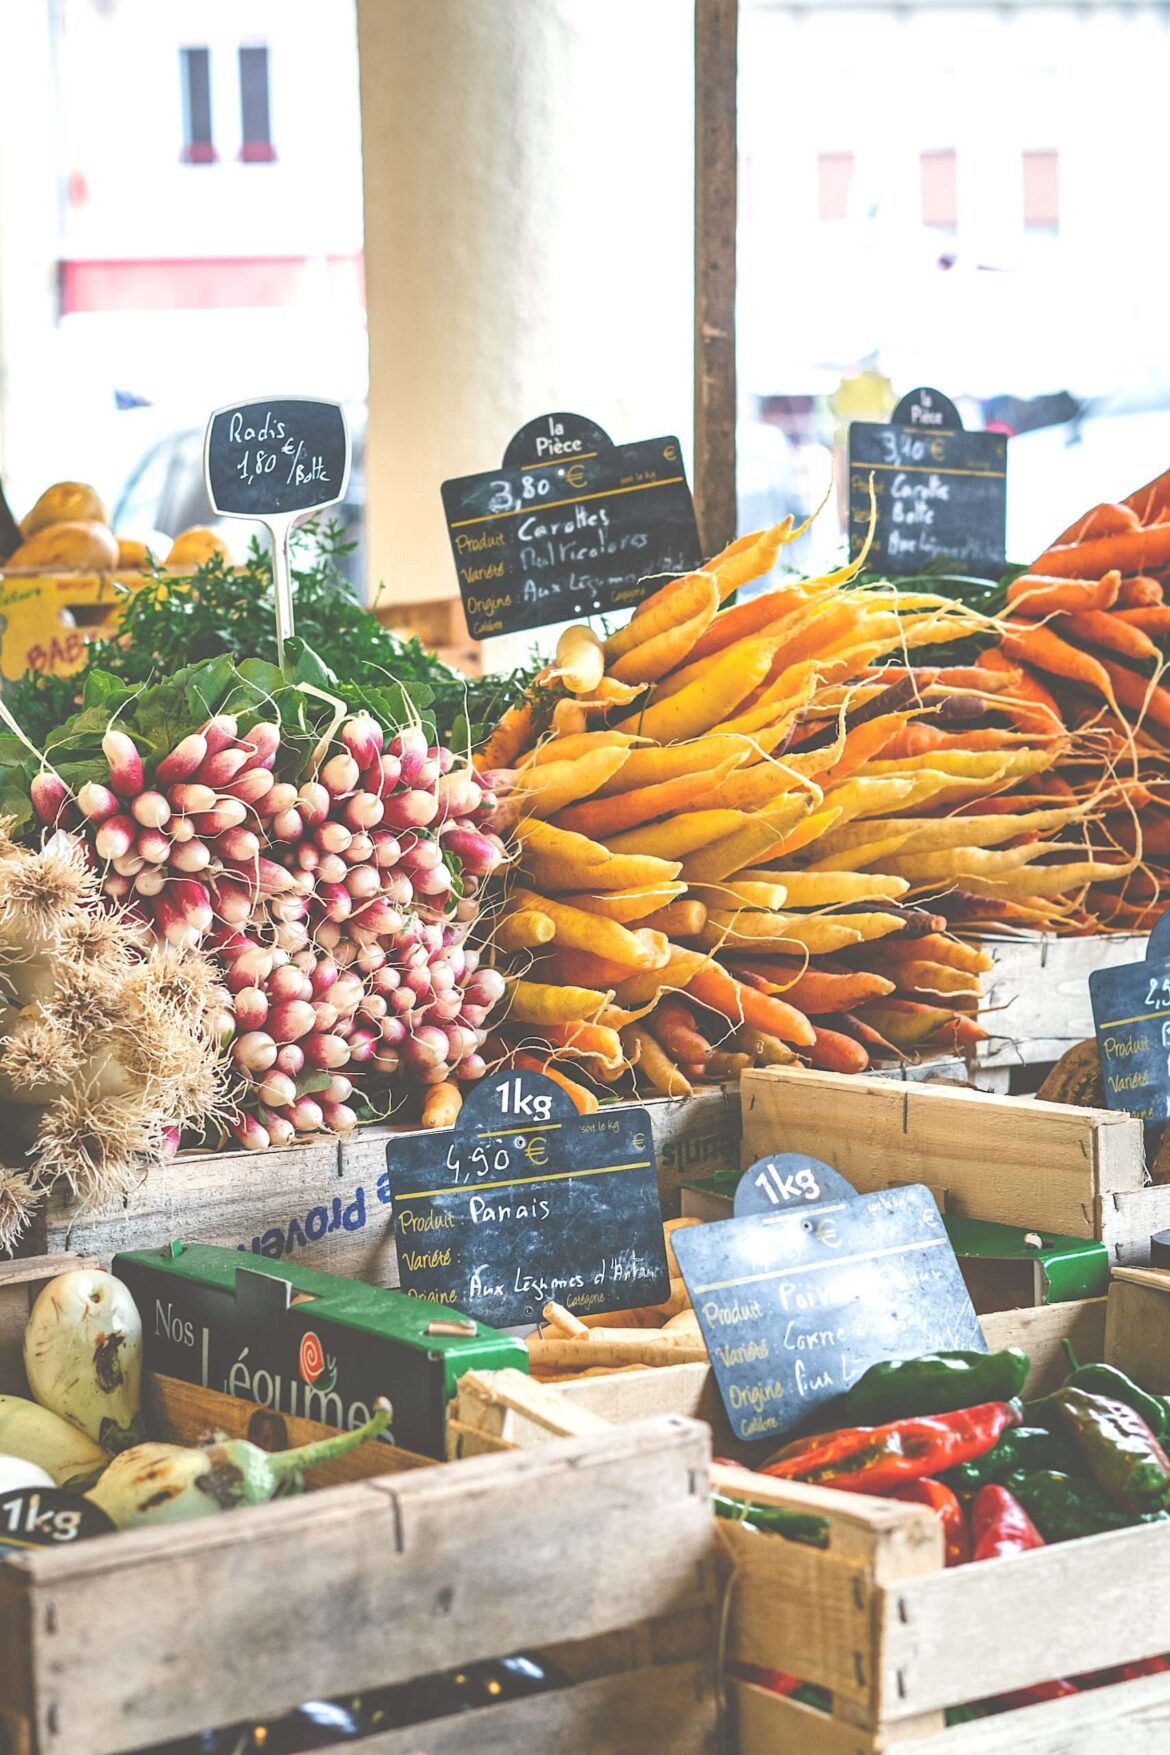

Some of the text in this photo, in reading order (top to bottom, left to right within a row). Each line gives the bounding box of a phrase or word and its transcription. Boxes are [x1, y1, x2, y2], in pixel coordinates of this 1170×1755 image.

[229, 411, 286, 443] Radis
[536, 417, 582, 457] la Pièce
[237, 450, 277, 485] 1,80
[488, 464, 588, 513] 3,80 €
[518, 504, 610, 541] Carottes
[1104, 1035, 1149, 1060] Produit
[1108, 1070, 1149, 1093] Variété
[496, 1077, 553, 1121] 1kg
[524, 1137, 549, 1165] €
[631, 1132, 646, 1150] €
[754, 1163, 821, 1205] 1kg
[399, 1196, 550, 1236] Produit Panais
[815, 1218, 843, 1249] €
[402, 1248, 451, 1272] Variété
[470, 1264, 505, 1298] Aux
[154, 1298, 195, 1348] Nos
[702, 1301, 763, 1329] Produit
[729, 1380, 785, 1413] Origine
[2, 1493, 83, 1541] 1kg
